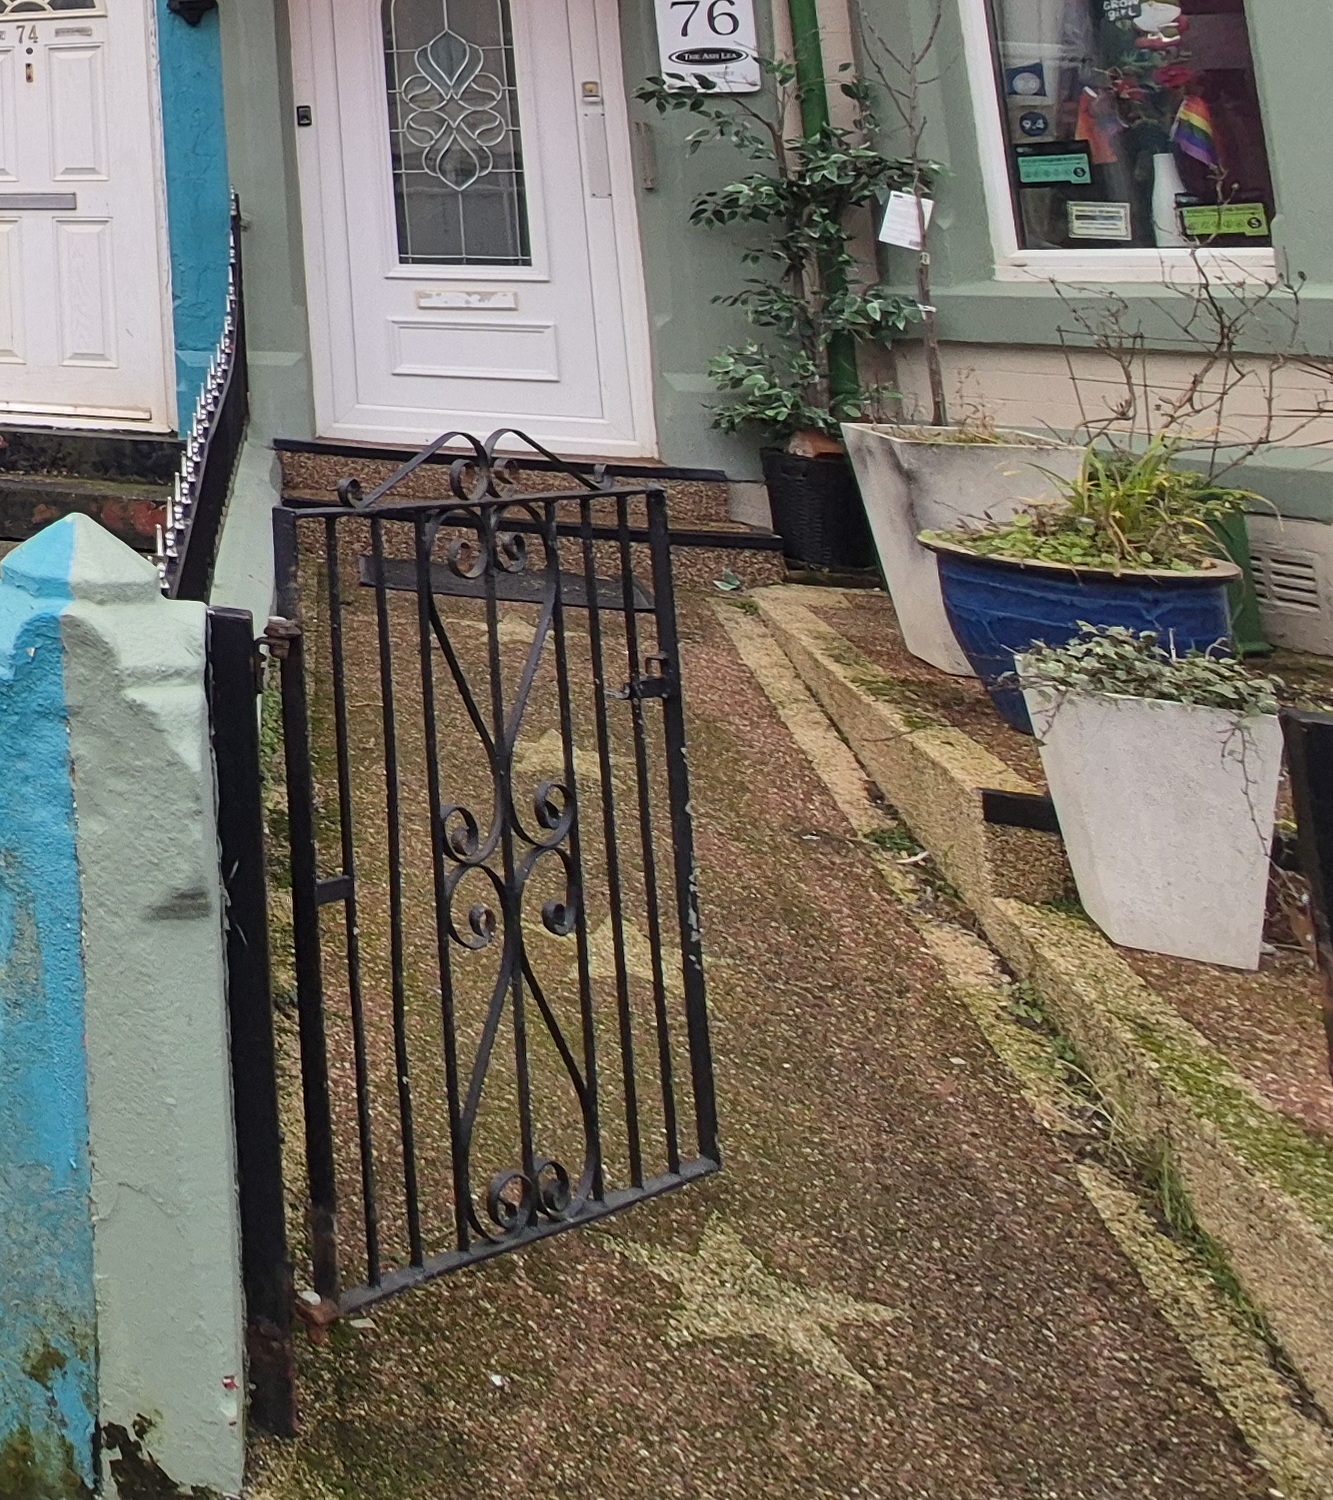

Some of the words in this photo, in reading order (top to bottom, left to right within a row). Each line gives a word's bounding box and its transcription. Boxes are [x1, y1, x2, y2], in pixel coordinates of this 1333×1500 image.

[16, 24, 39, 44] 74
[683, 53, 700, 61] THE
[721, 51, 737, 59] LEA
[1021, 118, 1045, 130] 9.4
